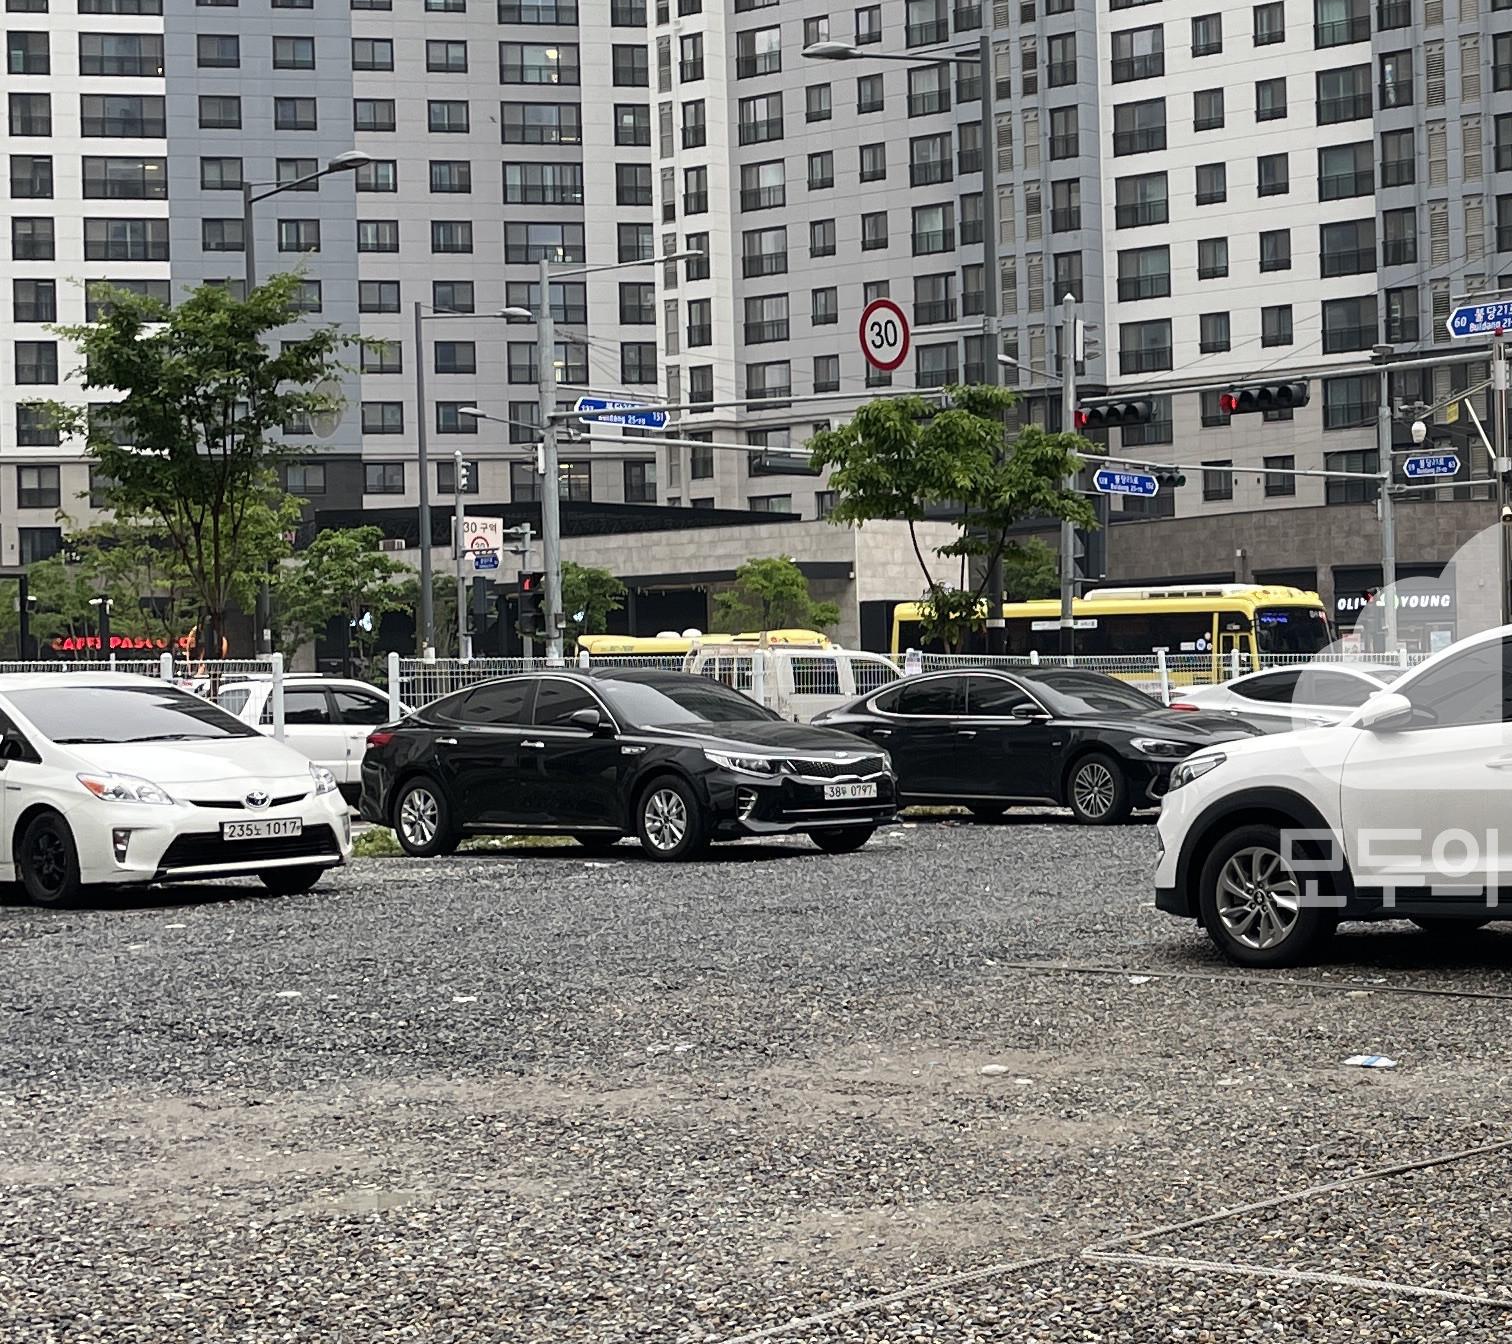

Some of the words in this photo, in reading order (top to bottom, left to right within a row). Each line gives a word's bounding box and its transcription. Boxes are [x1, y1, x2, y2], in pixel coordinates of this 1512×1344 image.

[1454, 317, 1467, 328] 60
[871, 319, 897, 349] 30
[1401, 593, 1451, 608] YOUNG
[266, 820, 297, 835] 1017
